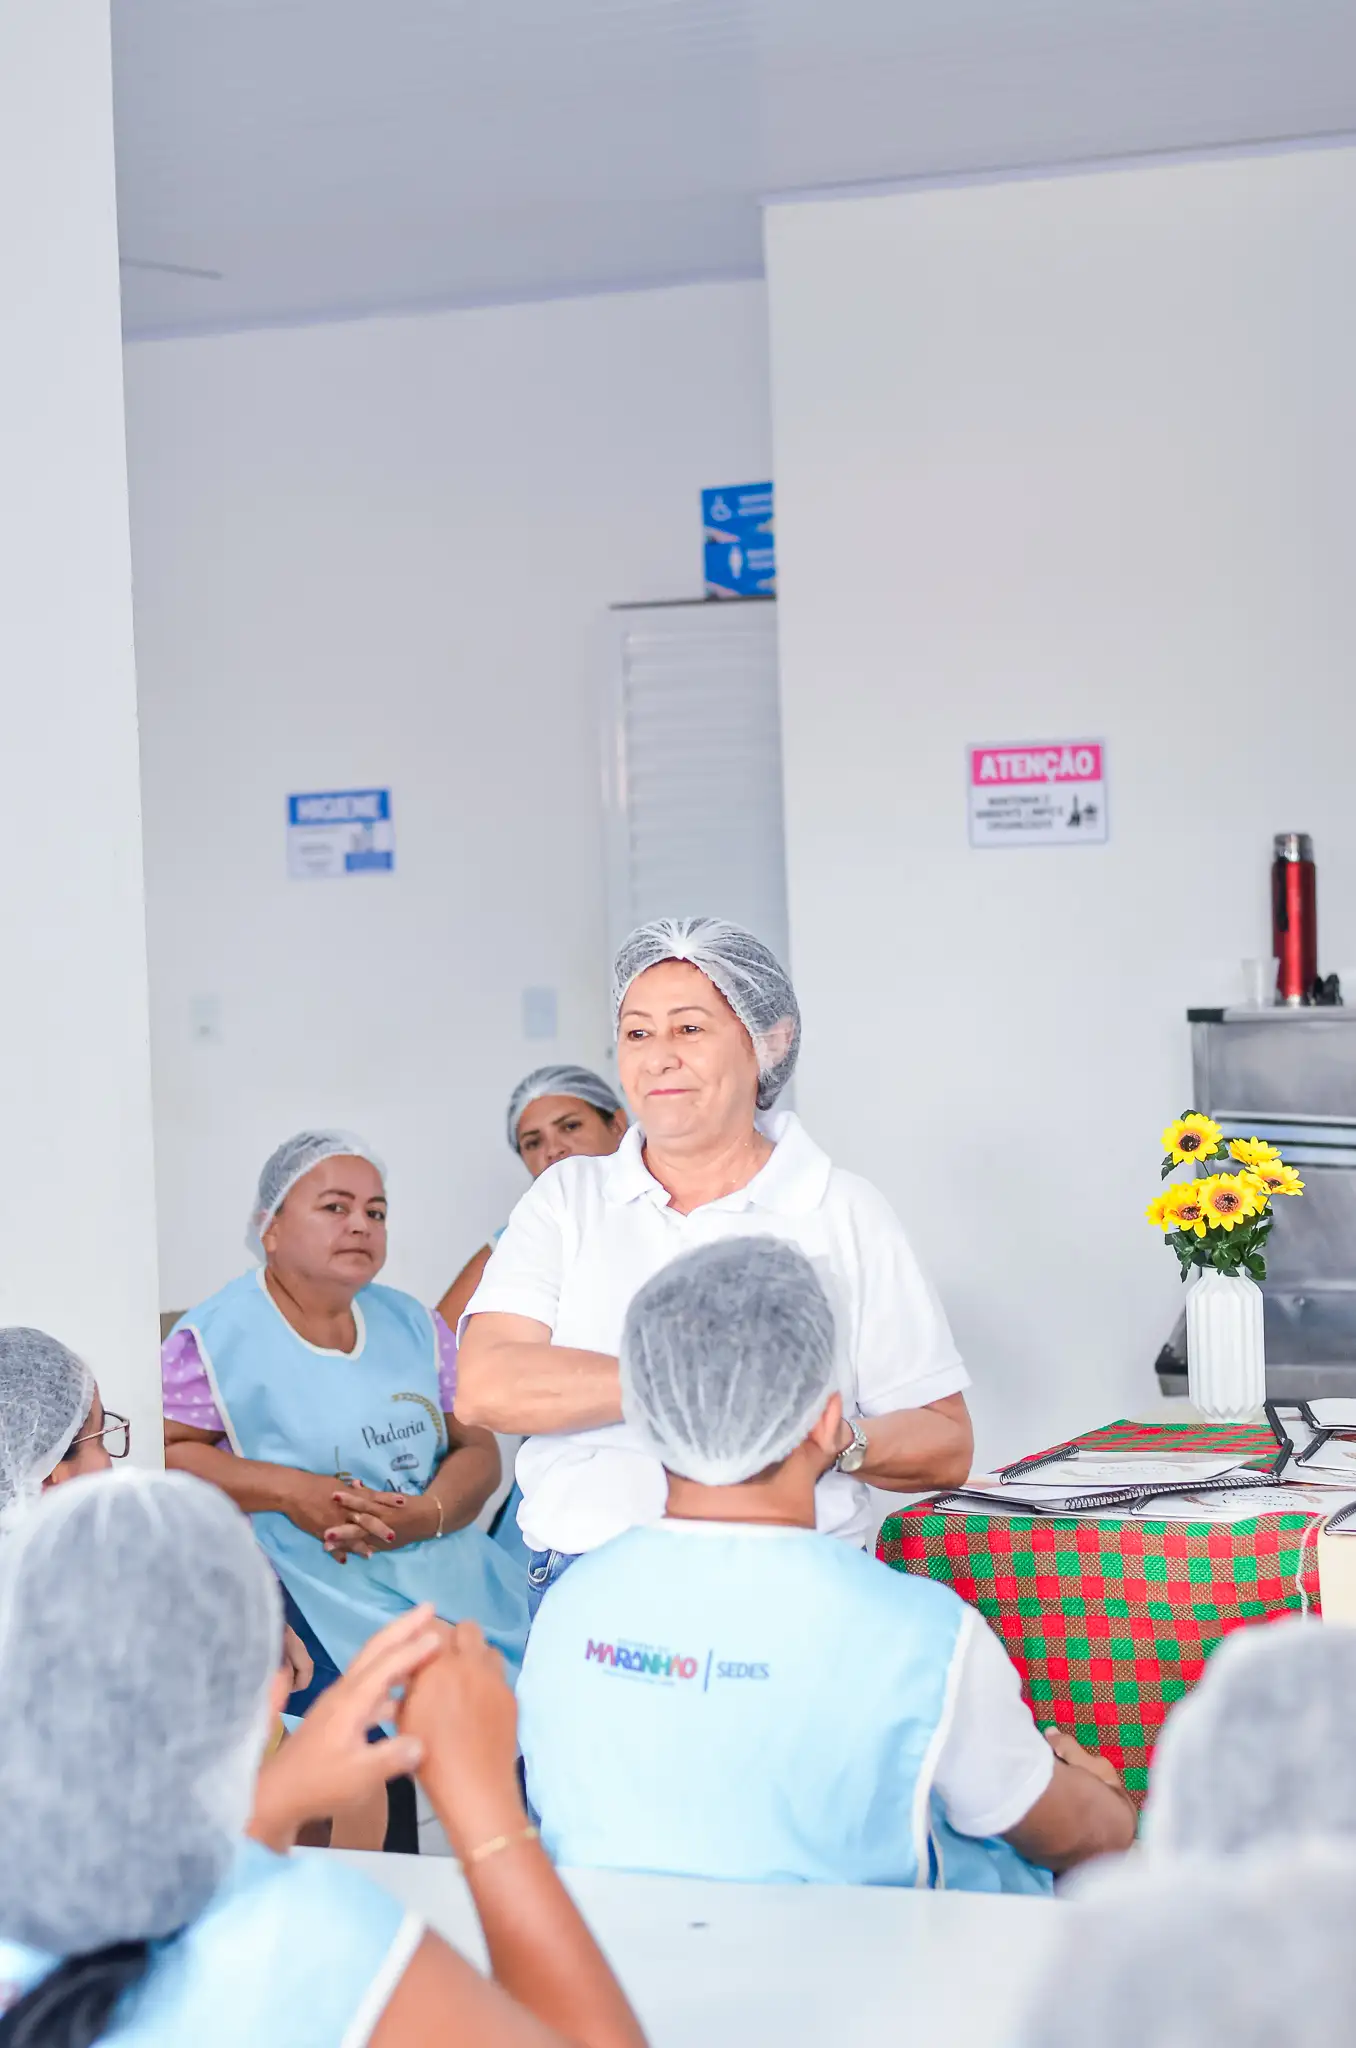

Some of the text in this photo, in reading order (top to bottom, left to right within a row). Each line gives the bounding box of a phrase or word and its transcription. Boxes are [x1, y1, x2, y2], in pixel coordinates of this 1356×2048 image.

[979, 747, 1095, 783] ATENÇÃO
[361, 1420, 427, 1449] Padaria
[716, 1661, 770, 1679] SEDES
